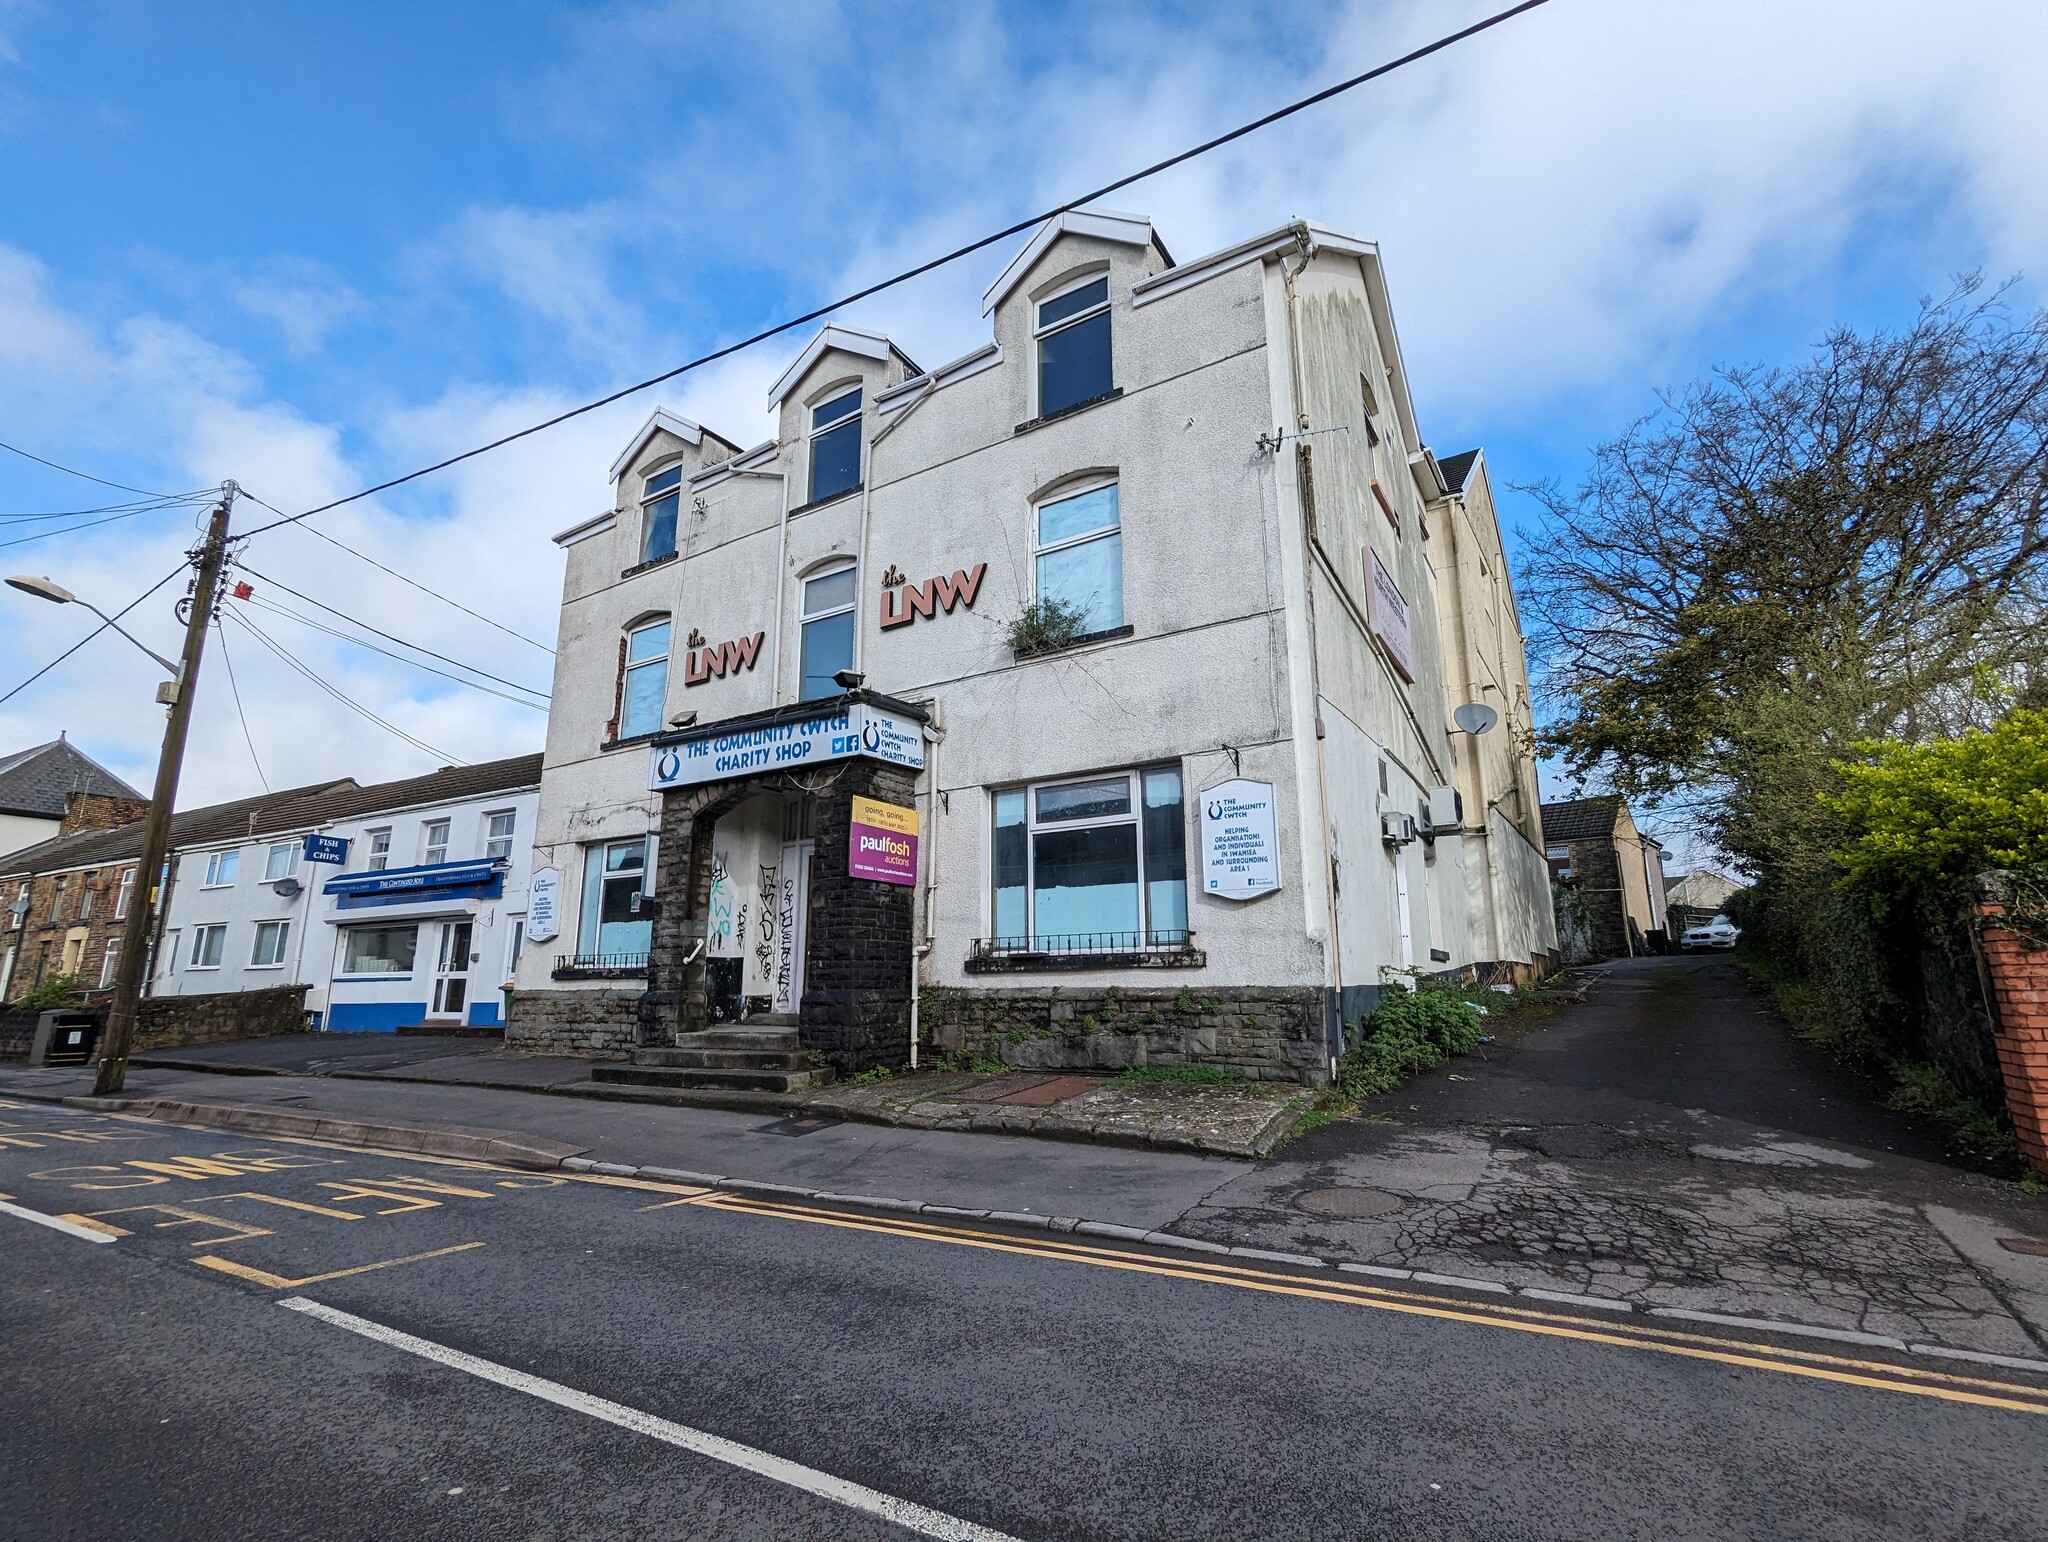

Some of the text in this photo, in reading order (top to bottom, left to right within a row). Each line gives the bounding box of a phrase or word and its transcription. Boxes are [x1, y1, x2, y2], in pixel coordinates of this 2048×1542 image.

[881, 564, 906, 587] the
[880, 562, 988, 631] LNW
[686, 627, 706, 649] the
[684, 631, 765, 688] LNW
[881, 719, 892, 729] THE
[687, 714, 849, 758] THE COMMUNITY CWTCH
[881, 730, 918, 746] COMMUNITY
[881, 740, 901, 751] CWTCH
[715, 741, 811, 772] CHARITY SHOP
[881, 750, 923, 766] CHARITY SHOP
[1224, 802, 1266, 812] COMMUNITY
[1224, 811, 1247, 819] CWTCH
[319, 839, 338, 847] FISH
[1215, 833, 1260, 843] ORGANISATIONS
[860, 835, 910, 857] paulfosh
[1228, 841, 1264, 850] INDIVIDUALS
[313, 852, 340, 861] CHIPS
[1230, 849, 1257, 857] SWANSEA
[885, 856, 910, 867] auctions
[1226, 856, 1268, 865] SURROUNDING
